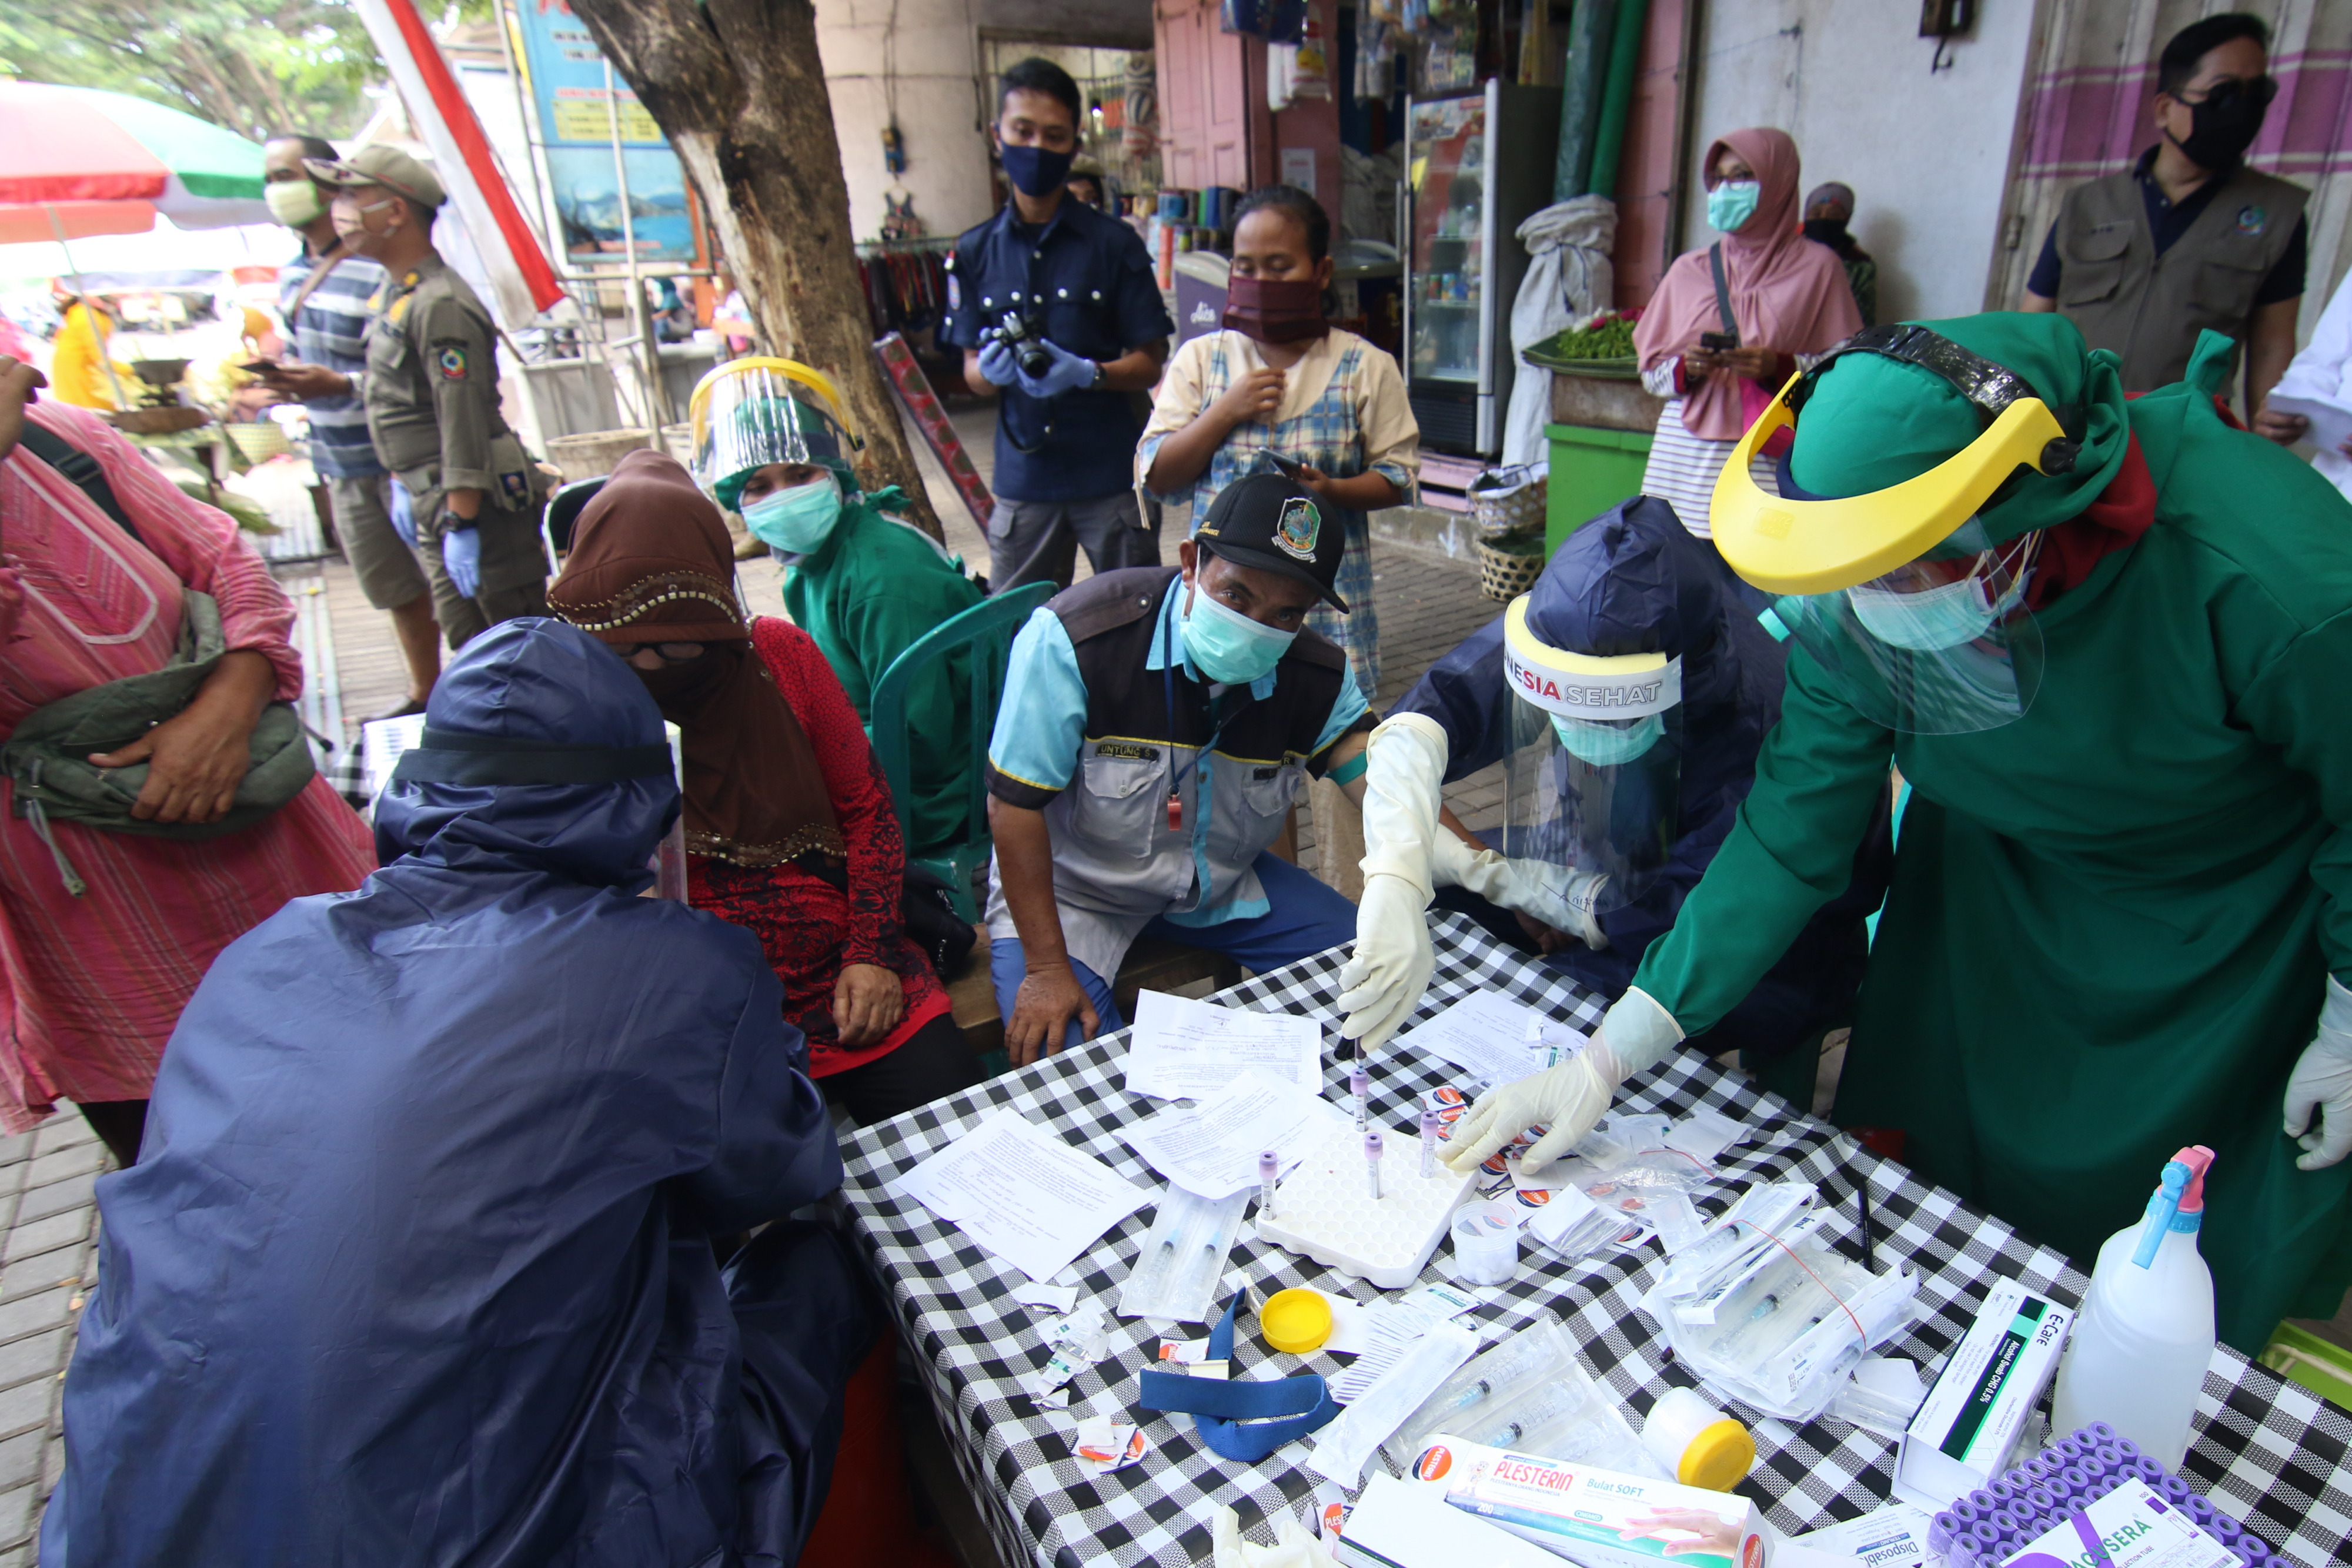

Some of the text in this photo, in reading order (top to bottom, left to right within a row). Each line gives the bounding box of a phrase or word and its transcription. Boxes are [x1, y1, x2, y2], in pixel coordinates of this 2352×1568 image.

[1504, 650, 1662, 707] NESIA SEHAT
[1101, 744, 1140, 756] UNTUNG
[1490, 1157, 1506, 1171] ESTERIN
[1529, 1190, 1546, 1203] STERIN
[1979, 1340, 2020, 1404] Alcohol Swab CHG 0.5%
[1423, 1447, 1445, 1479] PLESTERIN
[1494, 1461, 1573, 1492] PLESTERIN
[1586, 1478, 1614, 1492] Bulat
[1616, 1485, 1644, 1497] SOFT
[2139, 1491, 2150, 1500] 100
[1477, 1502, 1494, 1514] 200
[1880, 1535, 1900, 1545] TERUMO
[2141, 1546, 2154, 1557] TUBE
